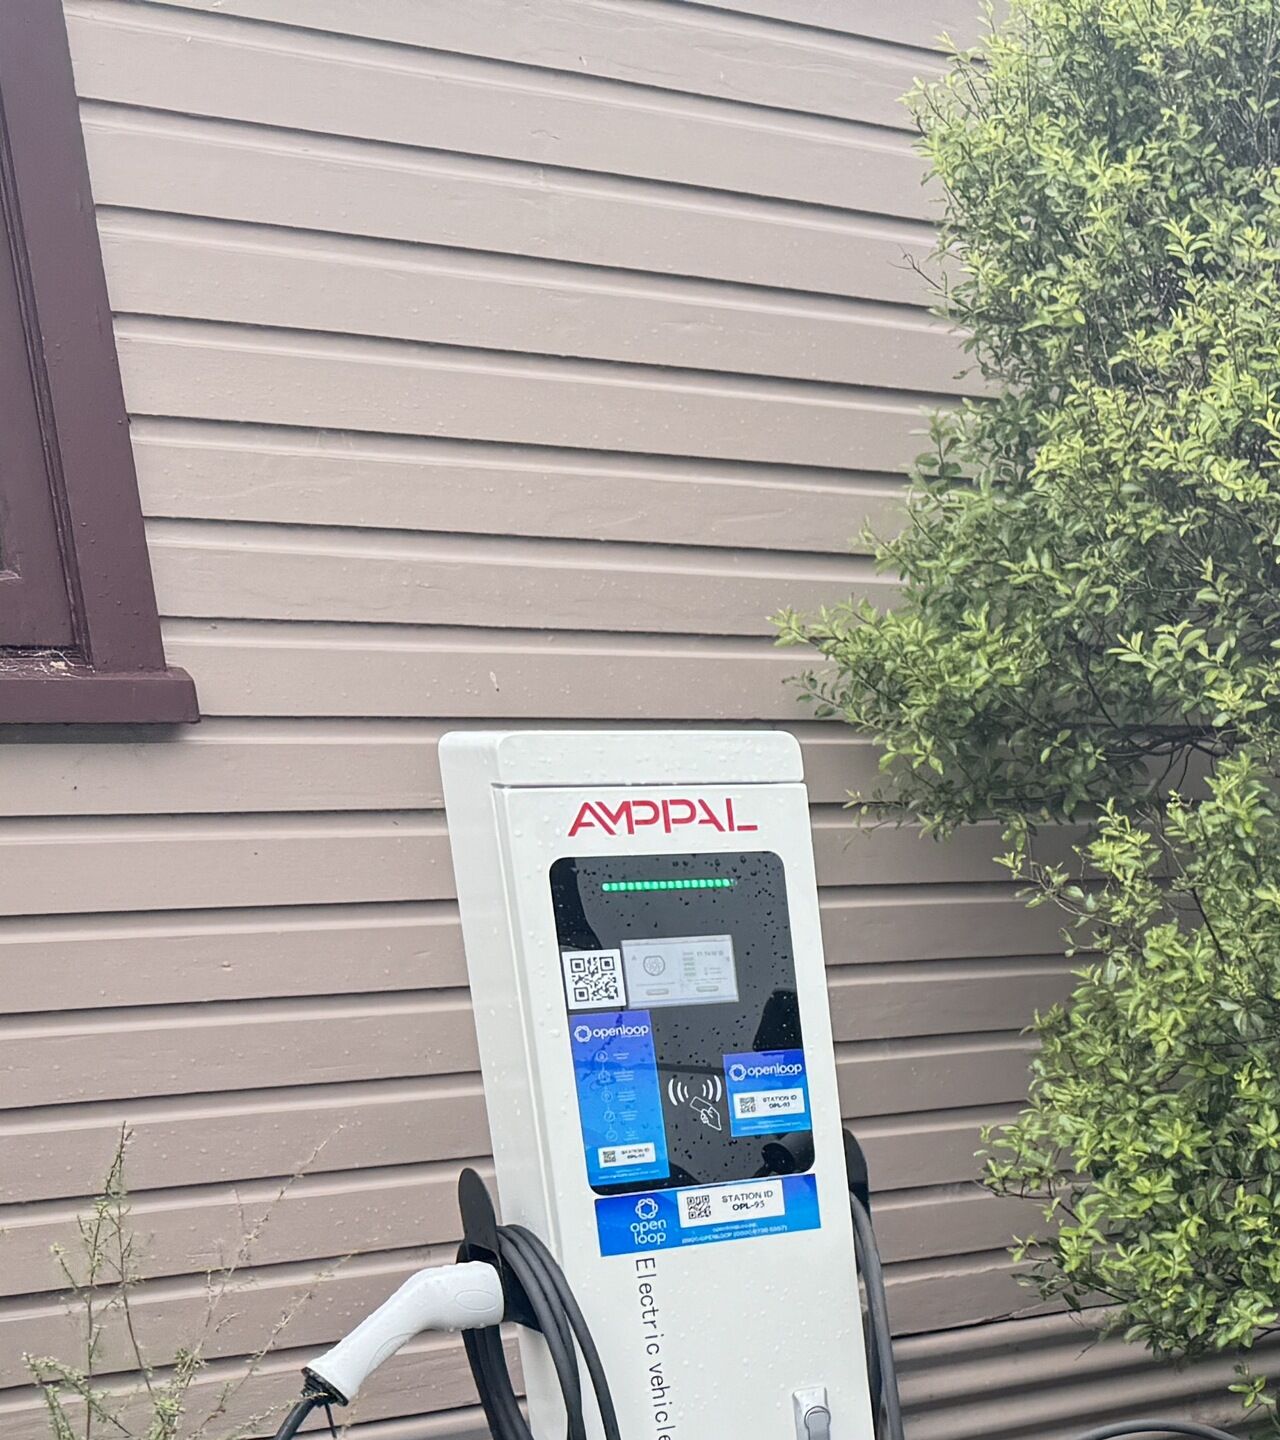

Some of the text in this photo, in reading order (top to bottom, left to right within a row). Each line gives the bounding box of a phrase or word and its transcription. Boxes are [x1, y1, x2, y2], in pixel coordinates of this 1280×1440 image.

[567, 798, 758, 837] AMPPAL
[592, 1024, 649, 1040] openloop
[747, 1063, 802, 1078] openloop
[721, 1190, 774, 1203] STATION ID
[630, 1218, 667, 1236] open
[634, 1231, 667, 1245] loop
[635, 1257, 664, 1356] Electric
